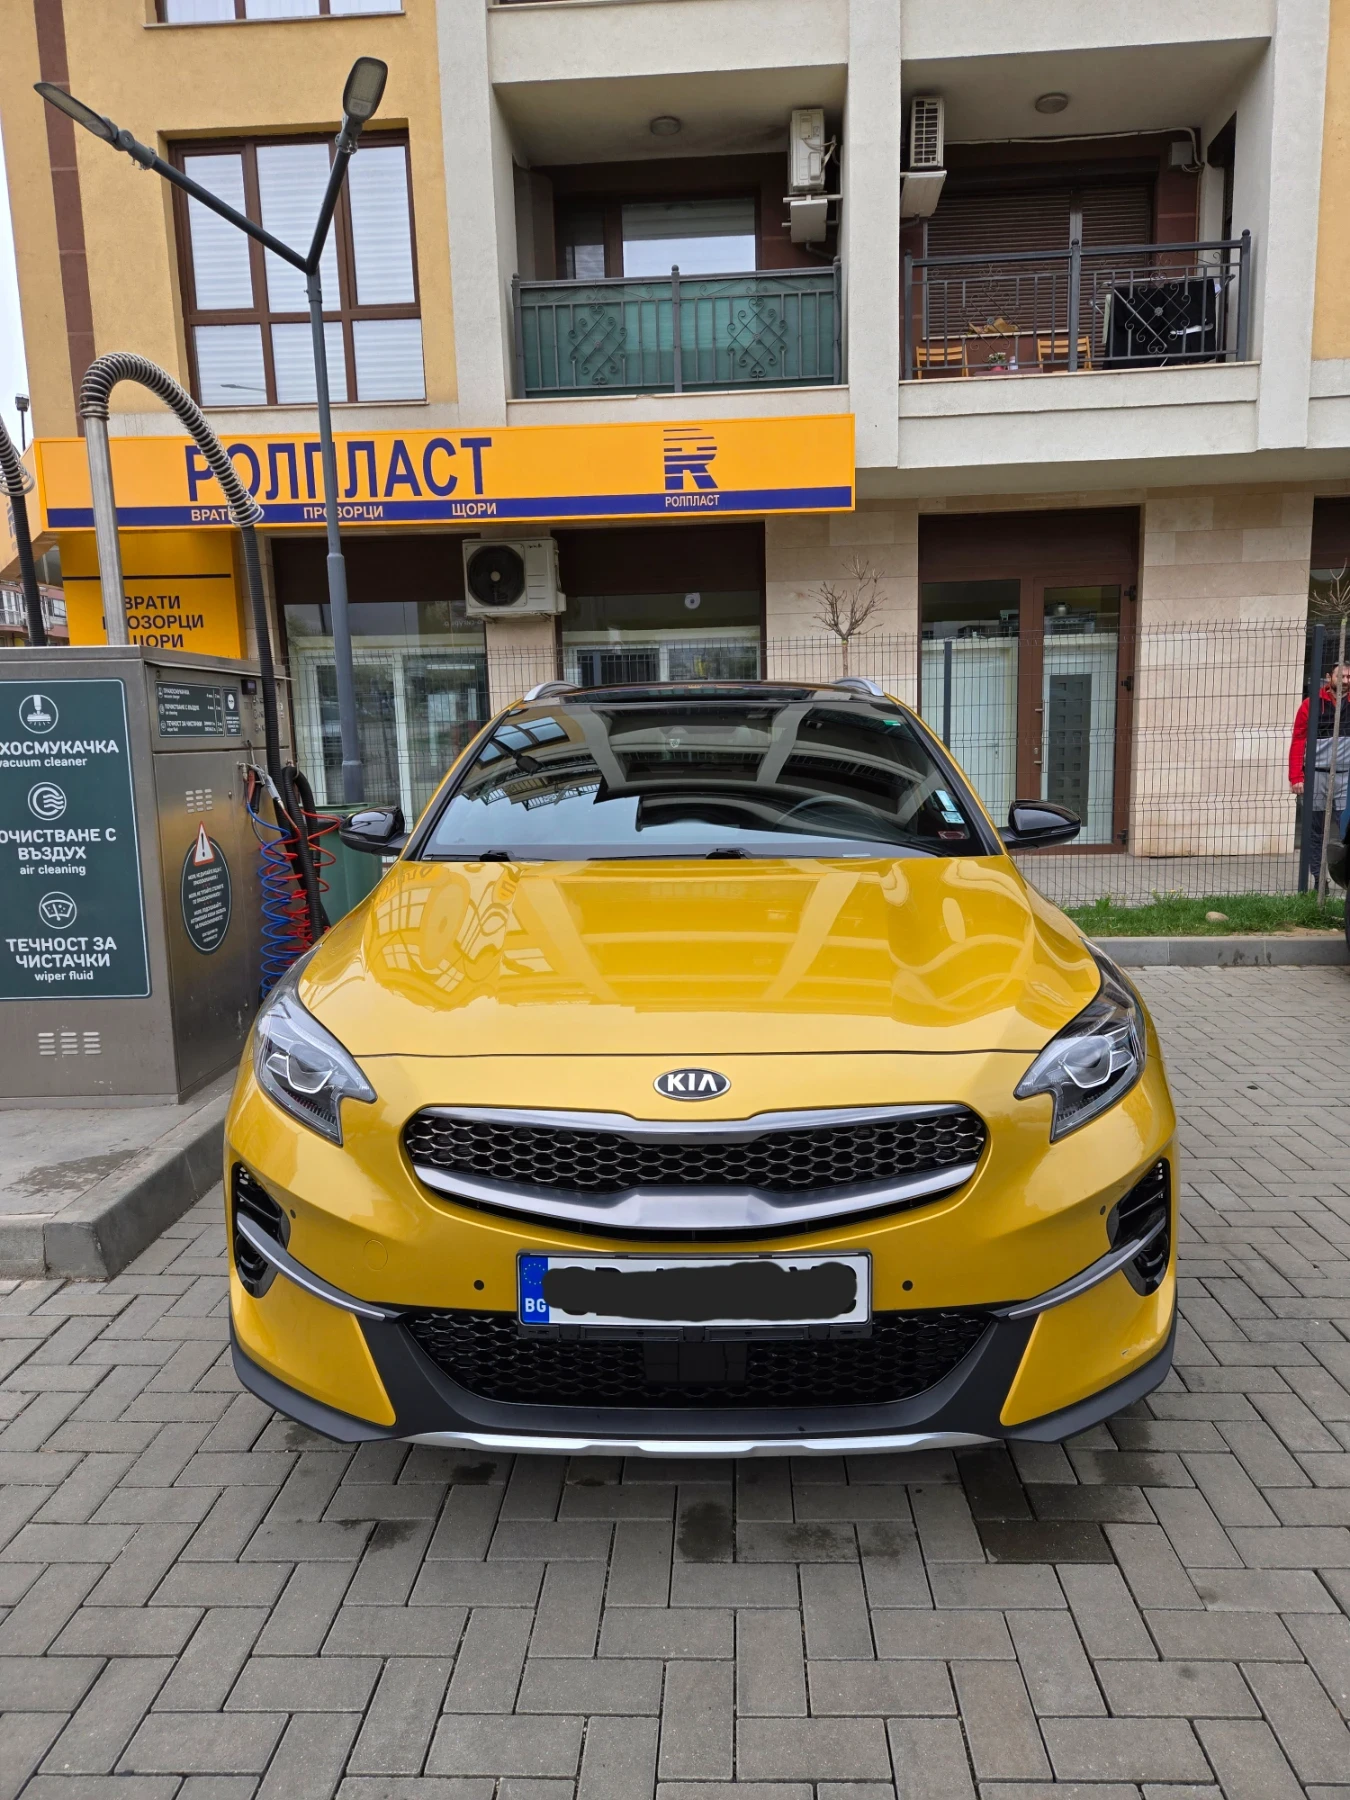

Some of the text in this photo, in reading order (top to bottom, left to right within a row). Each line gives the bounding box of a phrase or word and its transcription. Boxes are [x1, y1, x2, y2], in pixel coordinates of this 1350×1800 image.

[665, 494, 720, 507] РОЛПЛАСТ
[452, 503, 497, 518] ЩОРИ
[102, 614, 204, 631] ОЗОРЦИ
[44, 757, 88, 767] cleaner
[105, 828, 117, 842] С
[18, 846, 87, 862] ВЪЗДУХ
[20, 864, 86, 876] air cleaning
[5, 936, 117, 952] ТЕЧНОСТ ЗА
[15, 953, 110, 968] ЧИСТАЧКИ
[34, 970, 94, 983] wiper fluid
[667, 1073, 718, 1092] KIA
[525, 1297, 547, 1313] BG
